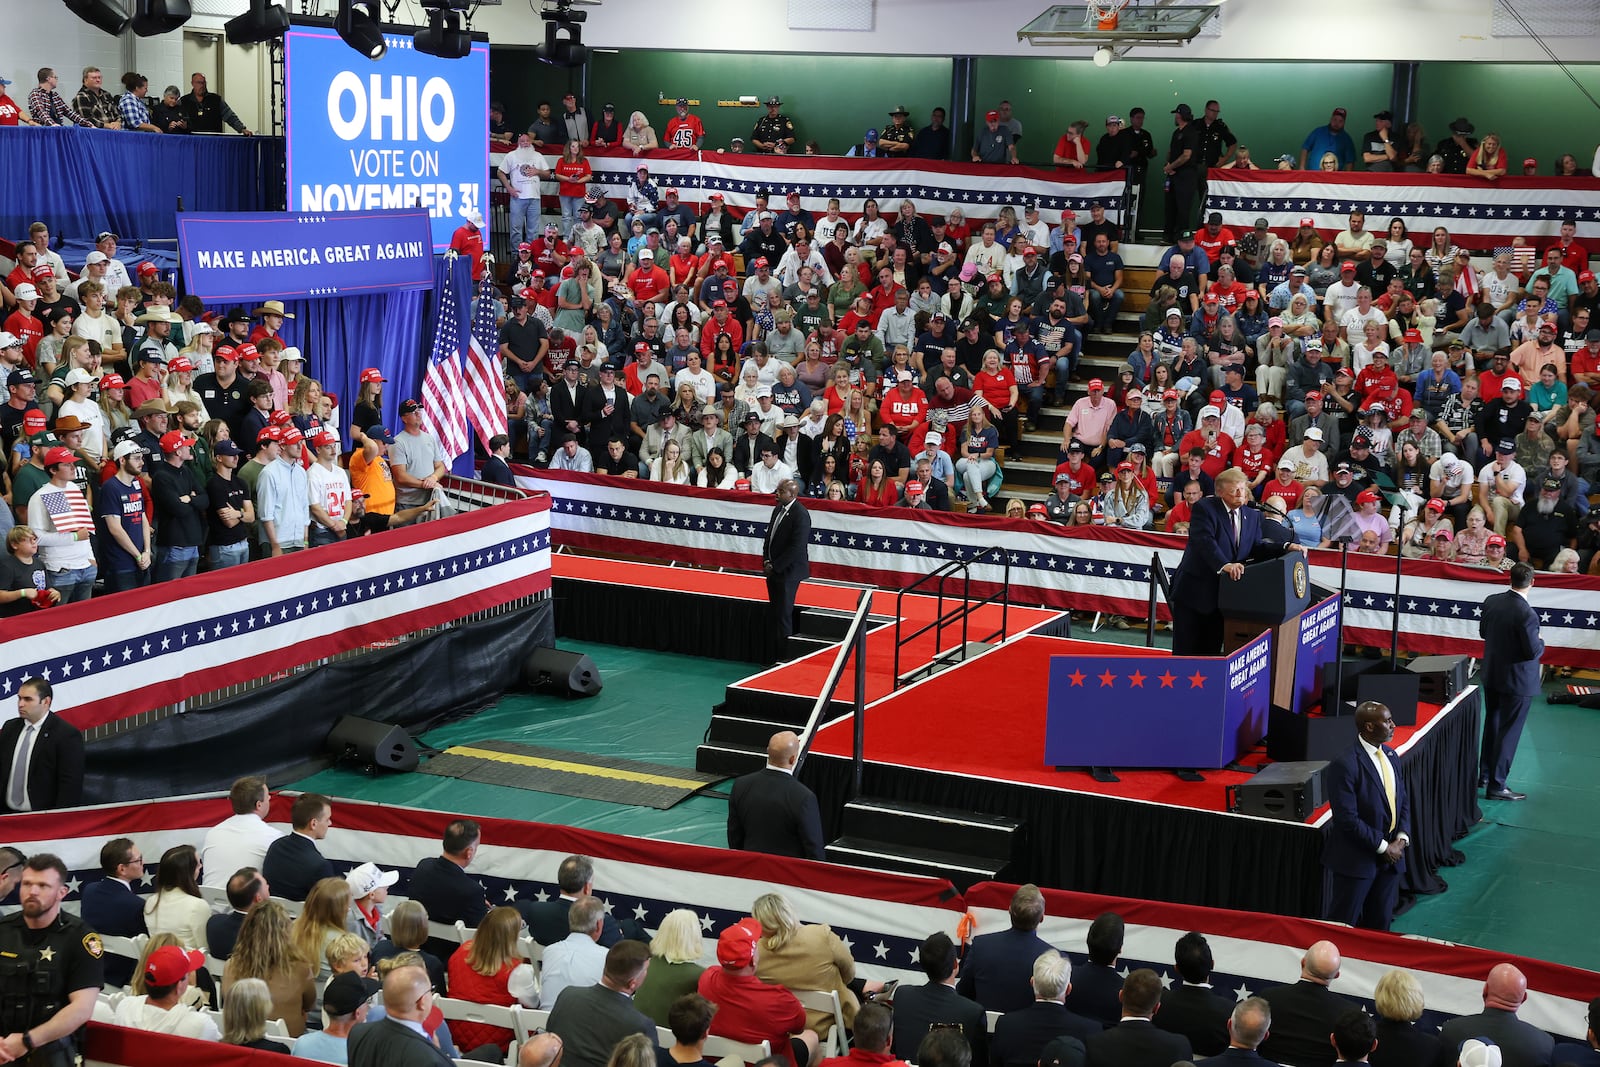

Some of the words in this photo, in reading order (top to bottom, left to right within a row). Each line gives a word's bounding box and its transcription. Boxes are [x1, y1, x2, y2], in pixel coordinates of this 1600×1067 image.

[327, 70, 455, 142] OHIO
[673, 129, 693, 147] 45
[350, 149, 404, 177] VOTE
[410, 150, 439, 177] ON
[301, 183, 453, 218] NOVEMBER
[458, 183, 479, 216] 3!
[823, 227, 834, 237] US
[197, 250, 246, 269] MAKE
[251, 247, 321, 268] AMERICA
[324, 244, 371, 264] GREAT
[376, 241, 424, 261] AGAIN!
[893, 402, 918, 414] USA
[1302, 613, 1316, 631] MAKE
[1317, 600, 1339, 623] AMERICA
[1302, 625, 1319, 645] GREAT
[1229, 654, 1245, 676] MAKE
[1246, 639, 1268, 664] AMERICA
[1230, 667, 1248, 690] GREAT
[1249, 654, 1267, 678] AGAIN!
